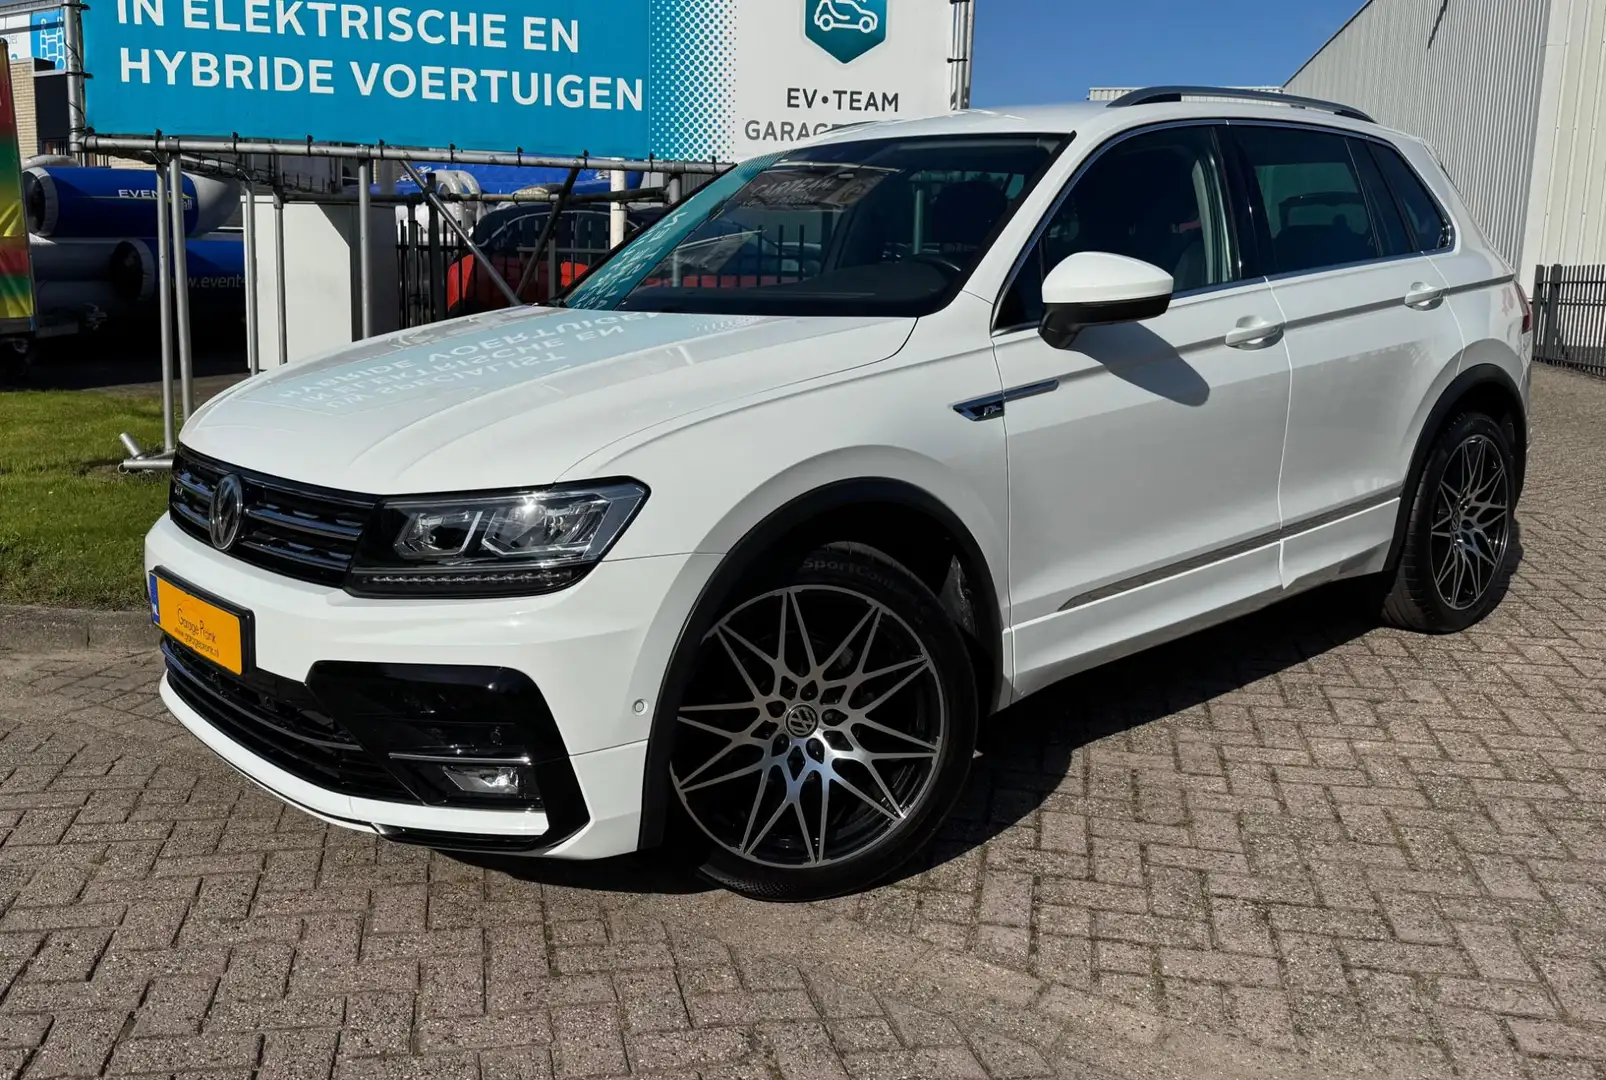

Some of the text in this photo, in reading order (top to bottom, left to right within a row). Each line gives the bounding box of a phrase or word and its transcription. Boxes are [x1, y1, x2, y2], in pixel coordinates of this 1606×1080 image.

[117, 0, 579, 53] IN ELEKTRISCHE EN
[120, 47, 643, 112] HYBRIDE VOERTUIGEN
[177, 607, 201, 636] Garage
